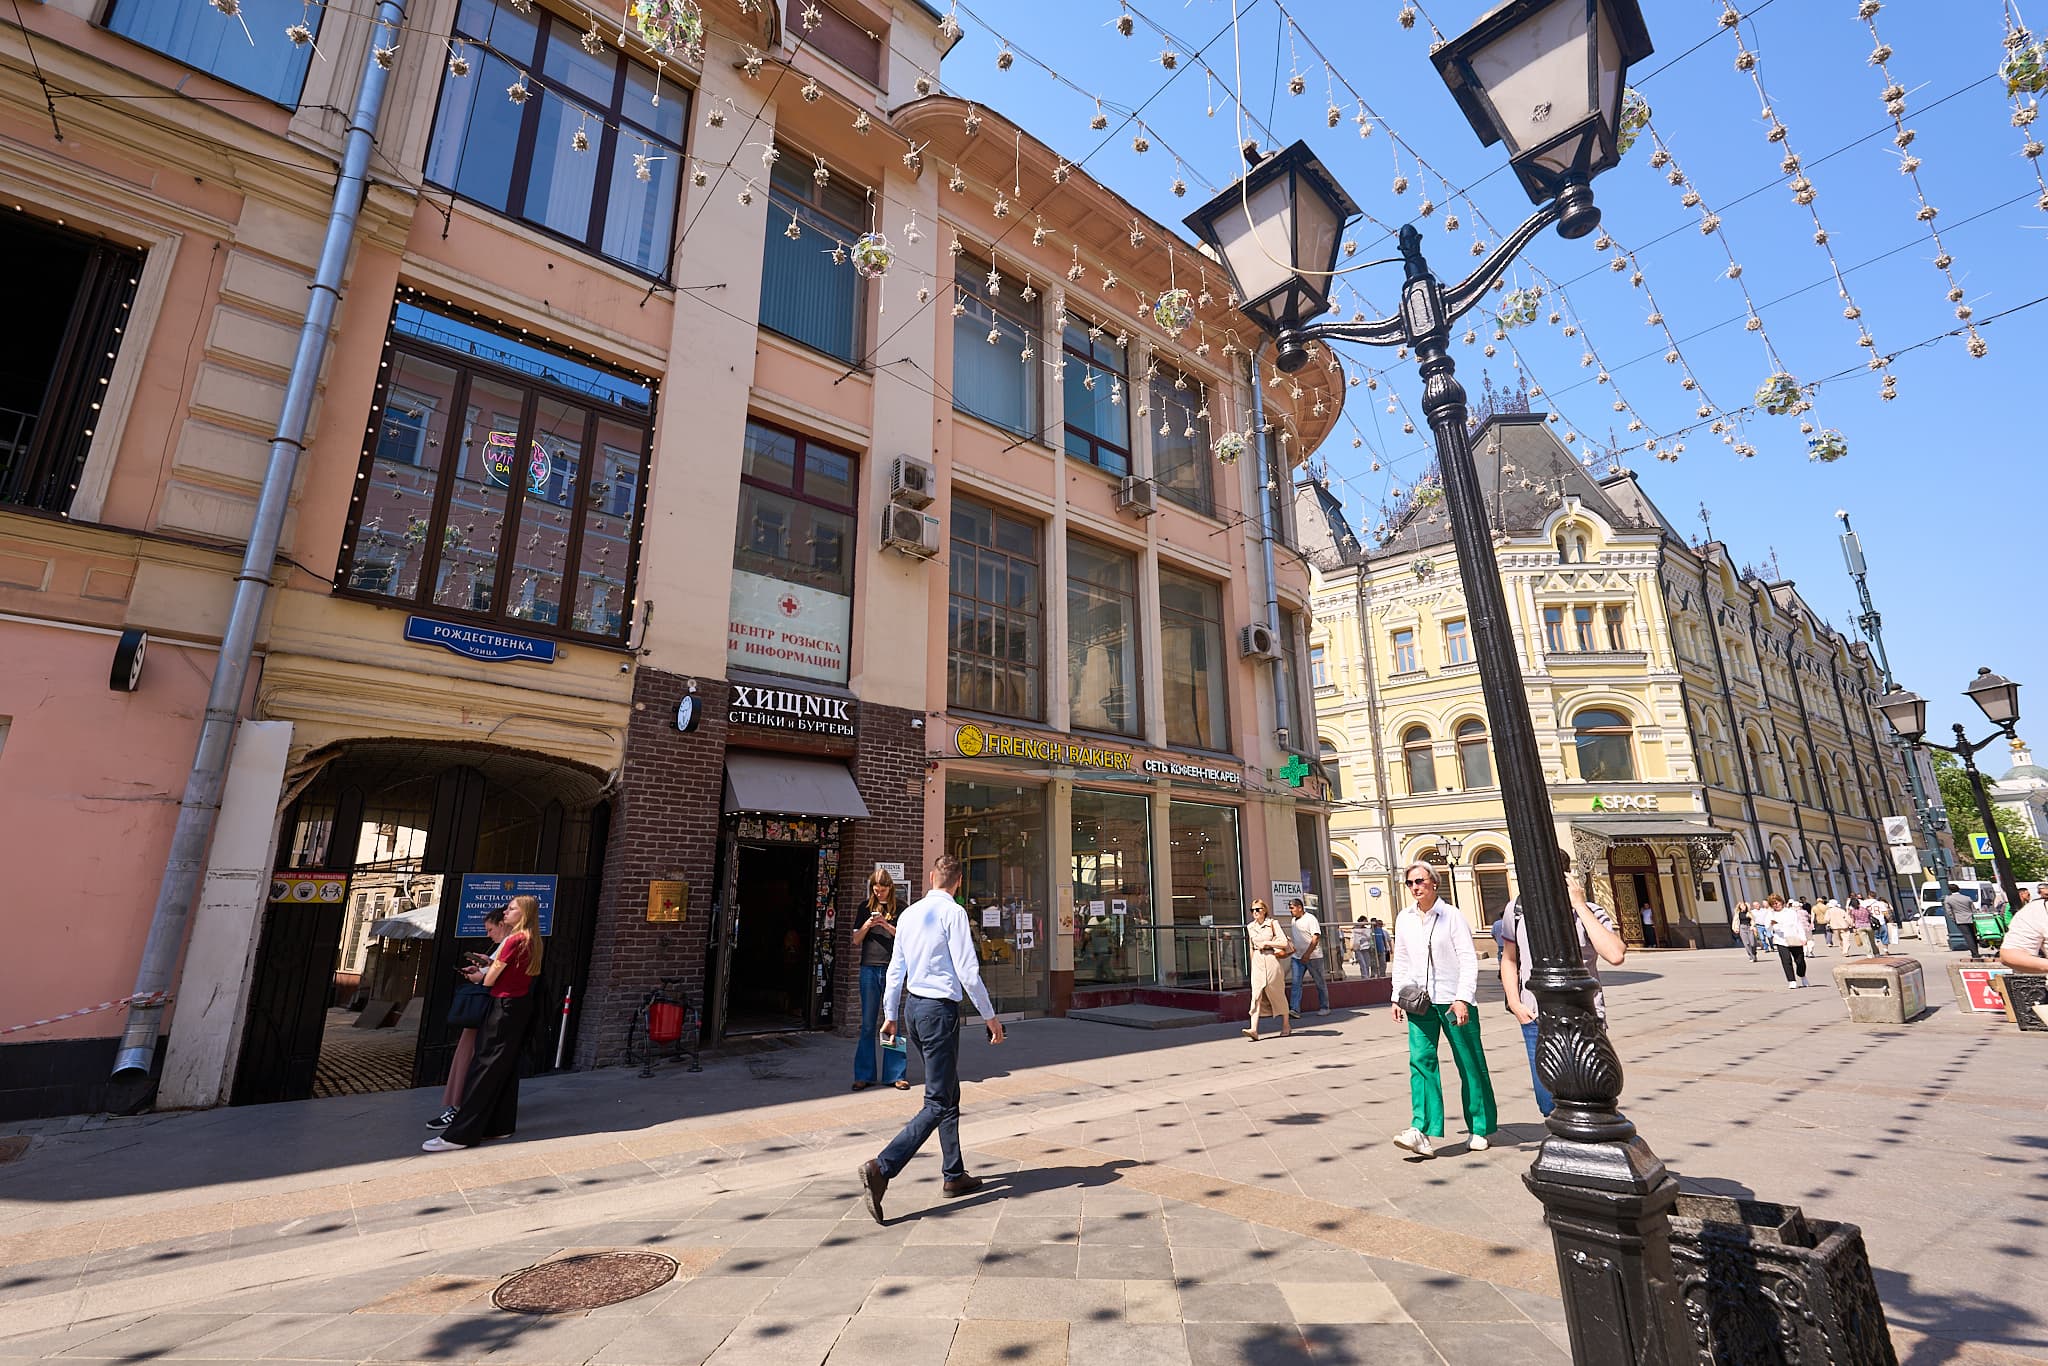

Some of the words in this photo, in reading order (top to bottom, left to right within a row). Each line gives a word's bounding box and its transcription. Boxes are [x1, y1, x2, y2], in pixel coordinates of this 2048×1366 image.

[496, 463, 510, 475] BA
[433, 626, 534, 652] РОЖДЕСТВЕНКА
[729, 622, 775, 640] ЦЕНТР
[781, 633, 841, 654] РОЗЫСКА
[728, 639, 739, 651] И
[745, 641, 841, 670] ИНФОРМАЦИИ
[732, 685, 850, 721] ХИЩNIK
[729, 711, 785, 727] СТЕЙКИ
[798, 719, 855, 736] БУРГЕРЫ
[988, 734, 1063, 762] FRENCH
[1069, 745, 1133, 770] BAKERY
[1145, 760, 1168, 773] СЕТЬ
[1170, 763, 1240, 784] КОФЕЕН-ПЕКАРЕН
[1592, 795, 1657, 809] ASPACE
[1273, 883, 1302, 894] АПТЕКА
